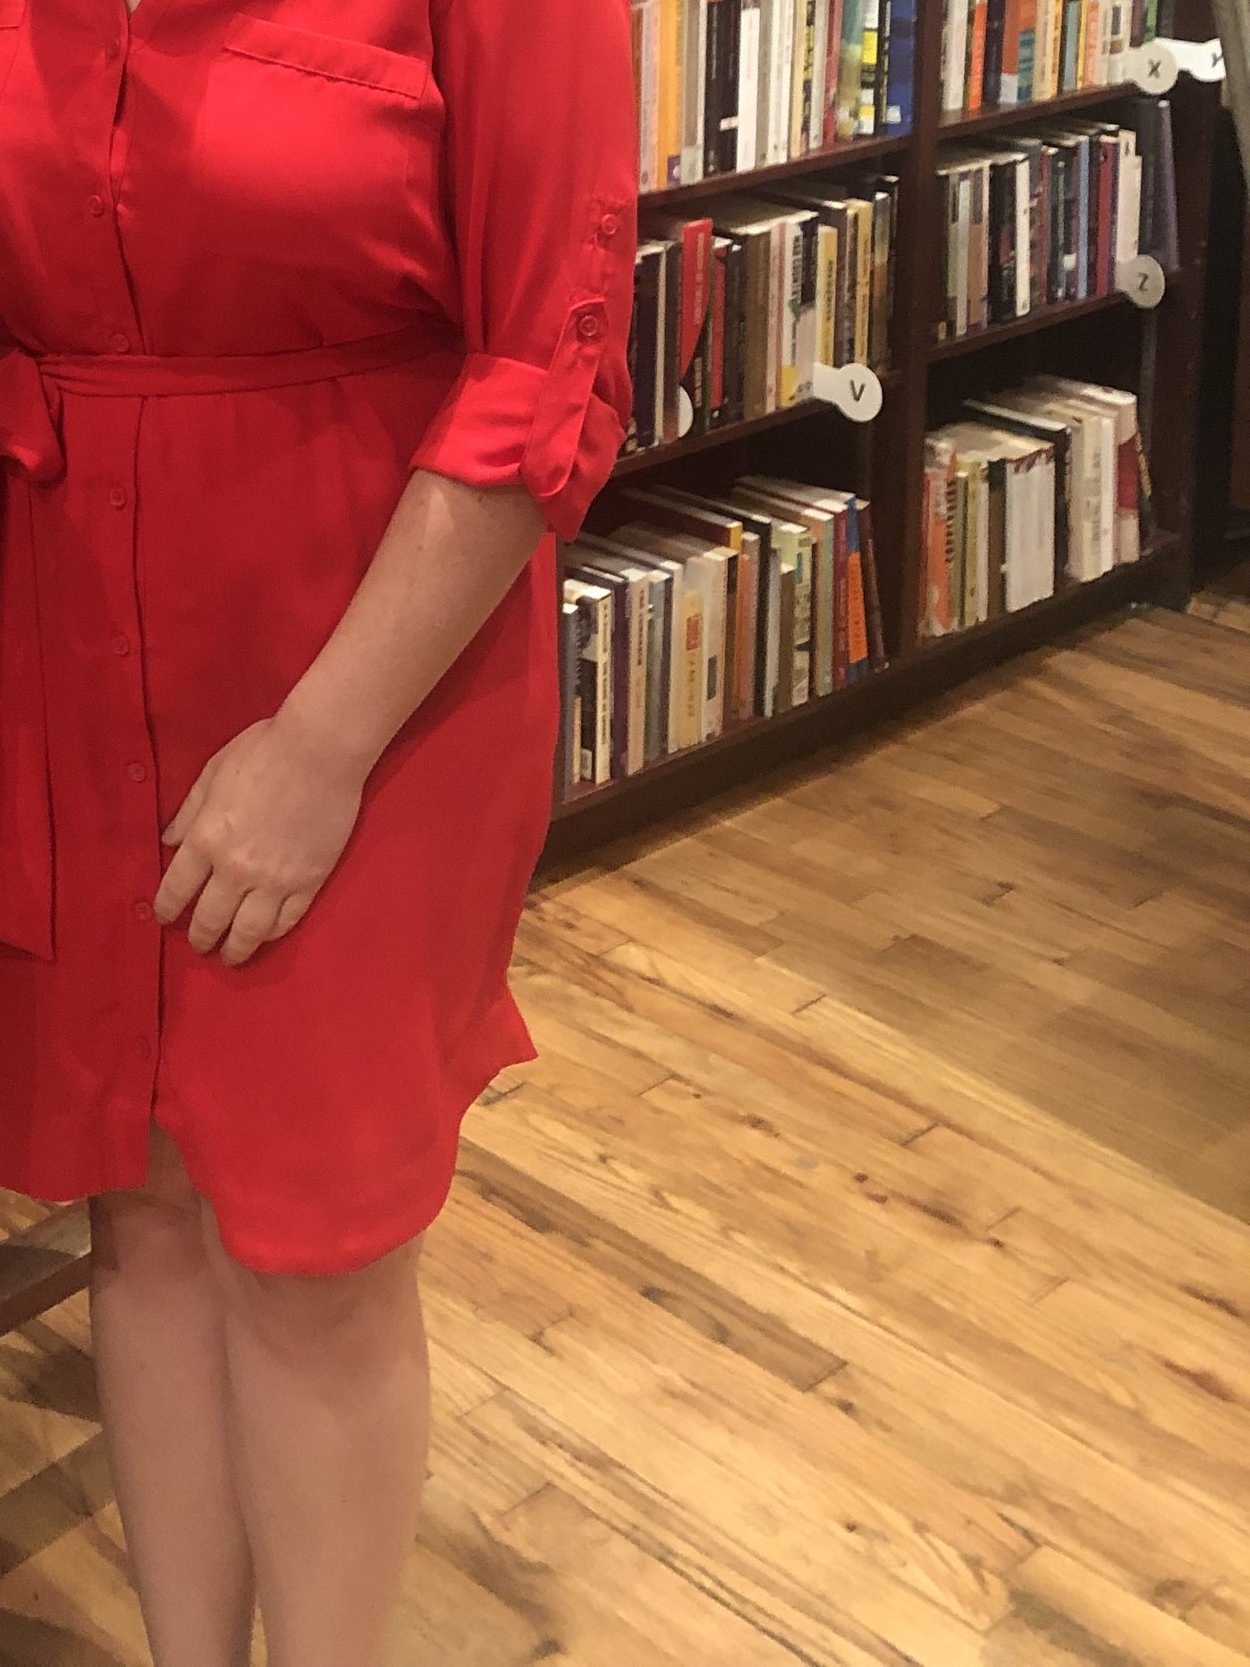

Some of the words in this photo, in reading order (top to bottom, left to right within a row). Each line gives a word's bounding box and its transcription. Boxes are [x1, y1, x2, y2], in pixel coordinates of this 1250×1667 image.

[1148, 59, 1162, 79] X
[1136, 273, 1150, 293] Z
[850, 380, 867, 403] V
